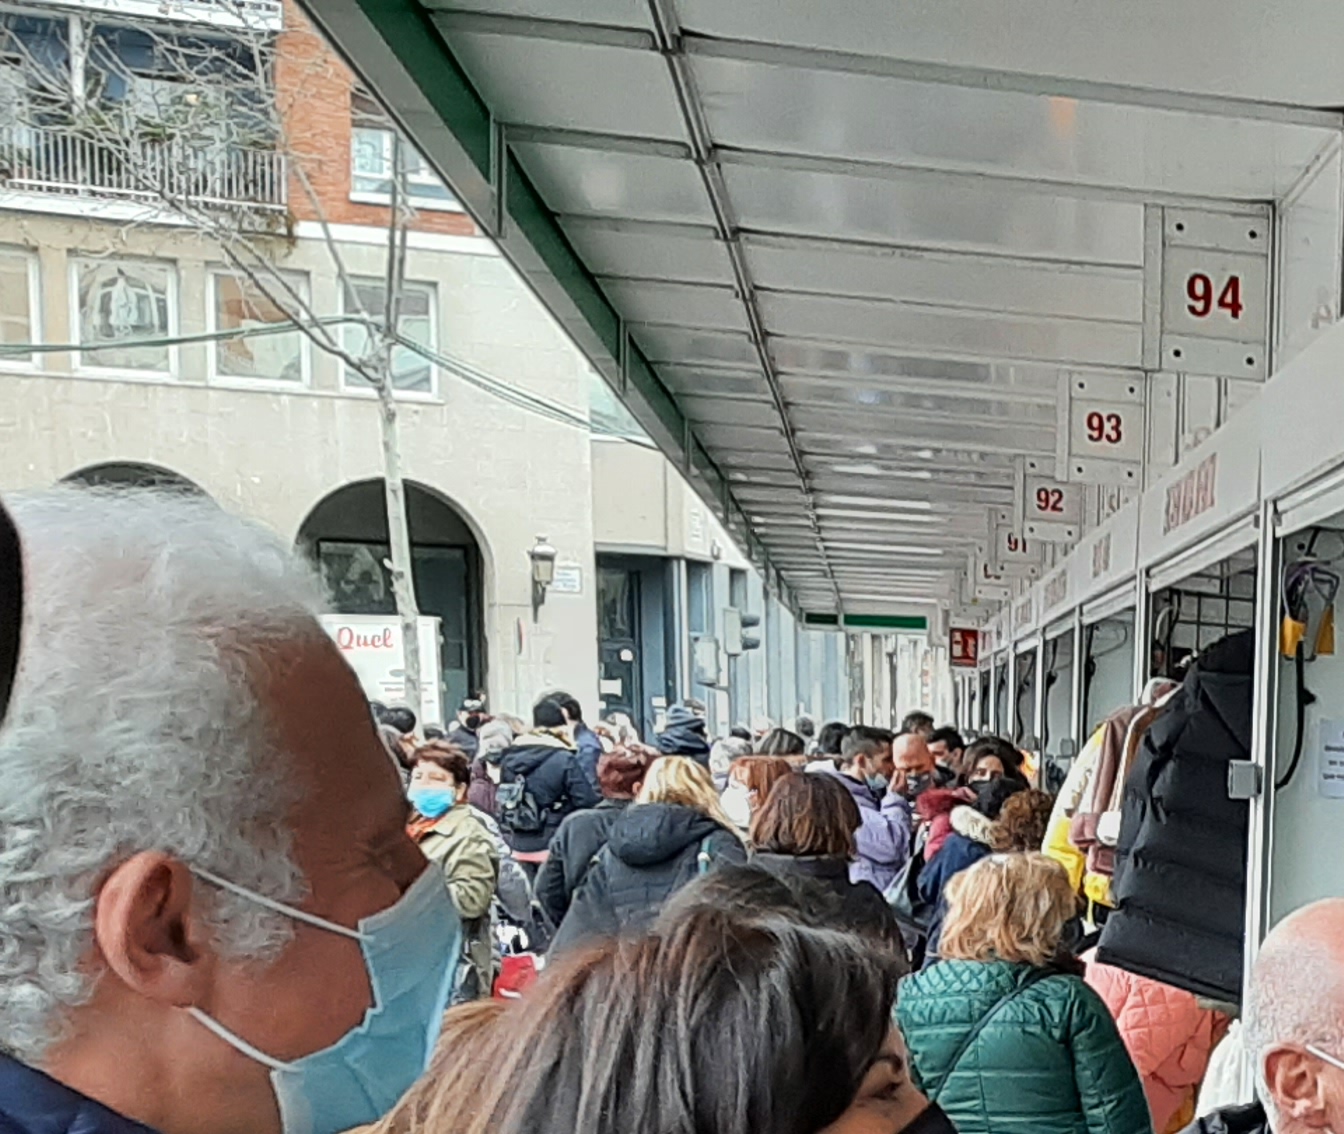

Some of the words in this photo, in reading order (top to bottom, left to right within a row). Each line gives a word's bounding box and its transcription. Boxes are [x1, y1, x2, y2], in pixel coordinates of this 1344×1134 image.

[1186, 272, 1243, 320] 94
[1085, 411, 1123, 444] 93
[1035, 487, 1064, 513] 92
